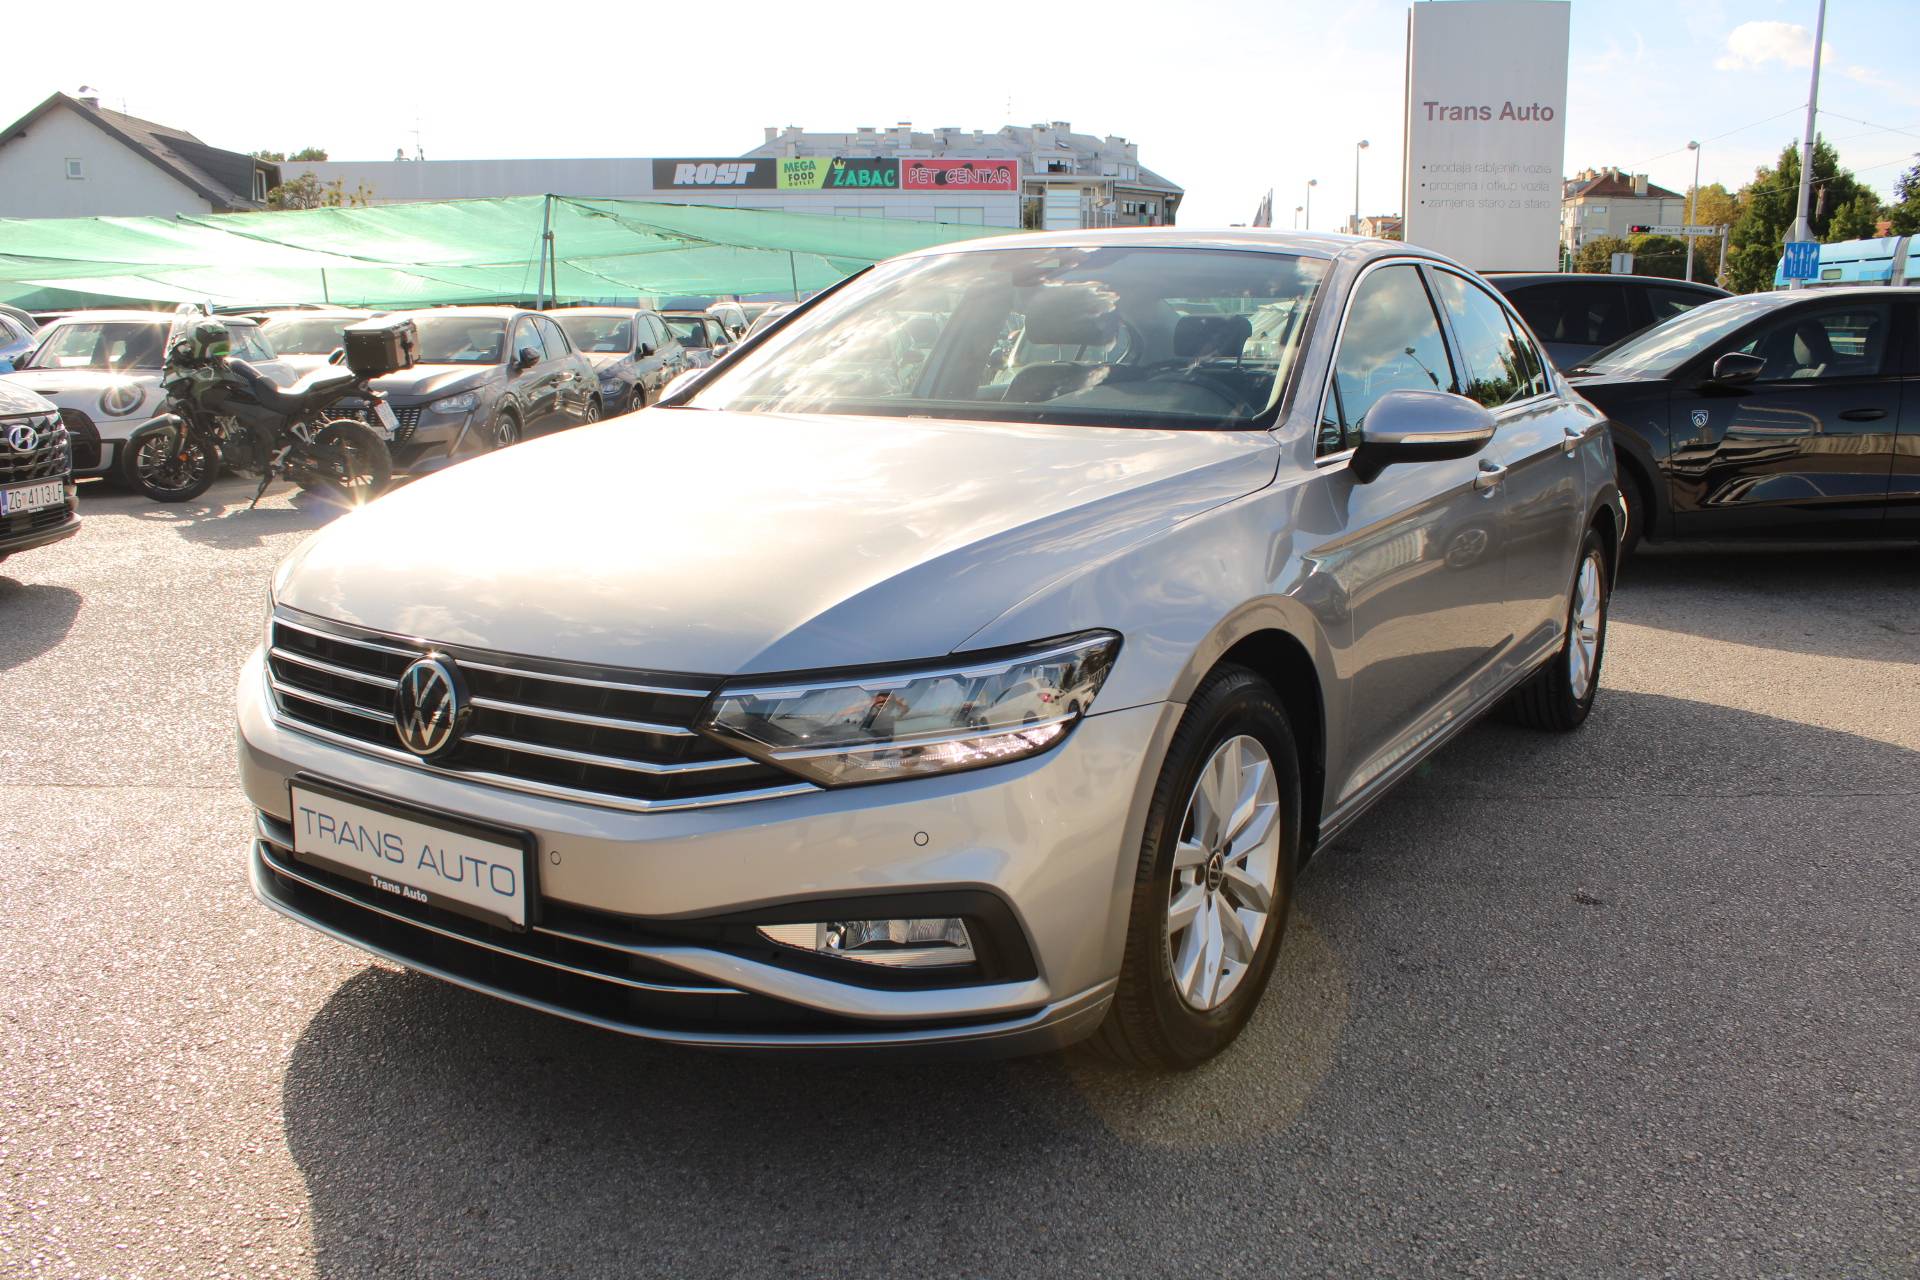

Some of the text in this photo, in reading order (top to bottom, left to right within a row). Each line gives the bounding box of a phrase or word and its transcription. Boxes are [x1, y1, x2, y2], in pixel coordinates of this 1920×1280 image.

[1423, 101, 1554, 121] Trans Auto
[673, 163, 756, 185] ROST
[783, 160, 817, 173] MEGA
[908, 167, 1012, 185] PET CENTAR
[788, 172, 815, 182] FOOD
[8, 491, 22, 510] ZG
[299, 806, 516, 897] TRANS AUTO
[370, 875, 428, 903] Trans Auto
